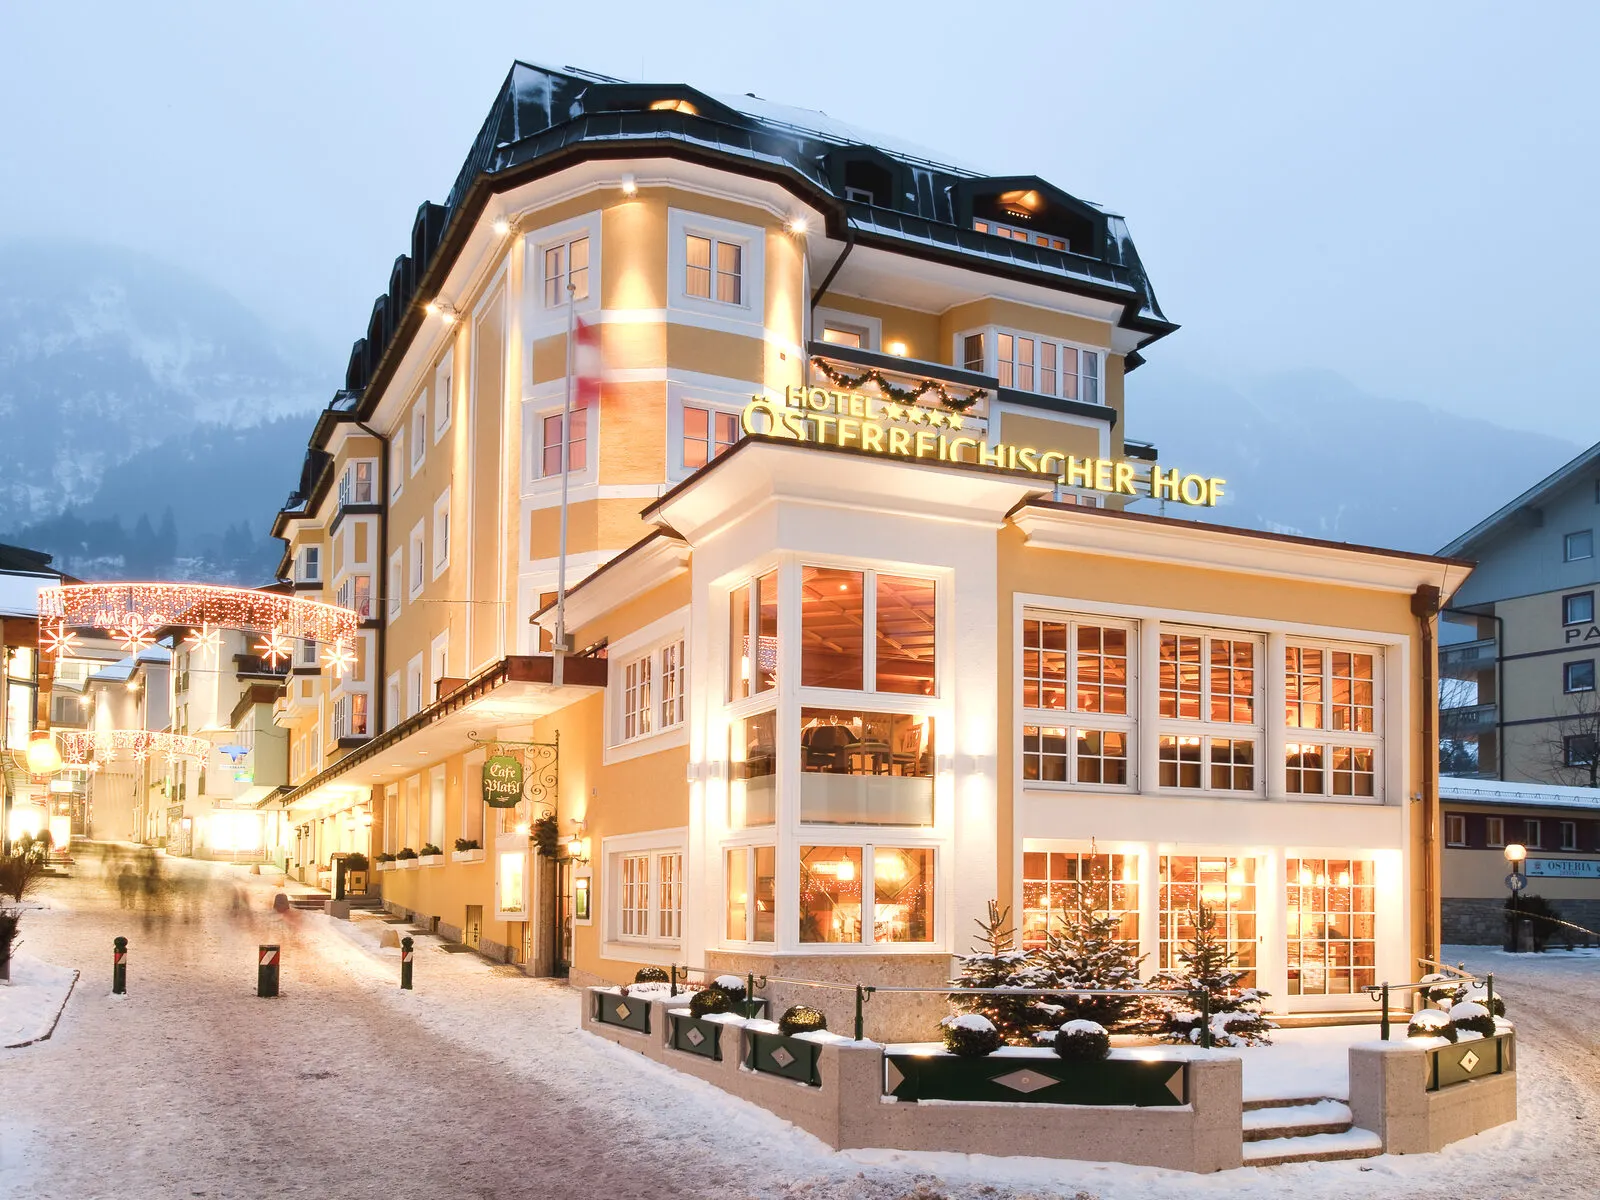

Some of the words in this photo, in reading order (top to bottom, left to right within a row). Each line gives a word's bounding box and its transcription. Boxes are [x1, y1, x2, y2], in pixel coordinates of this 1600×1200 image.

[786, 385, 880, 420] HOTEL
[1151, 465, 1227, 507] HOF
[485, 779, 520, 799] Platzl
[1548, 861, 1591, 871] OSTERIA
